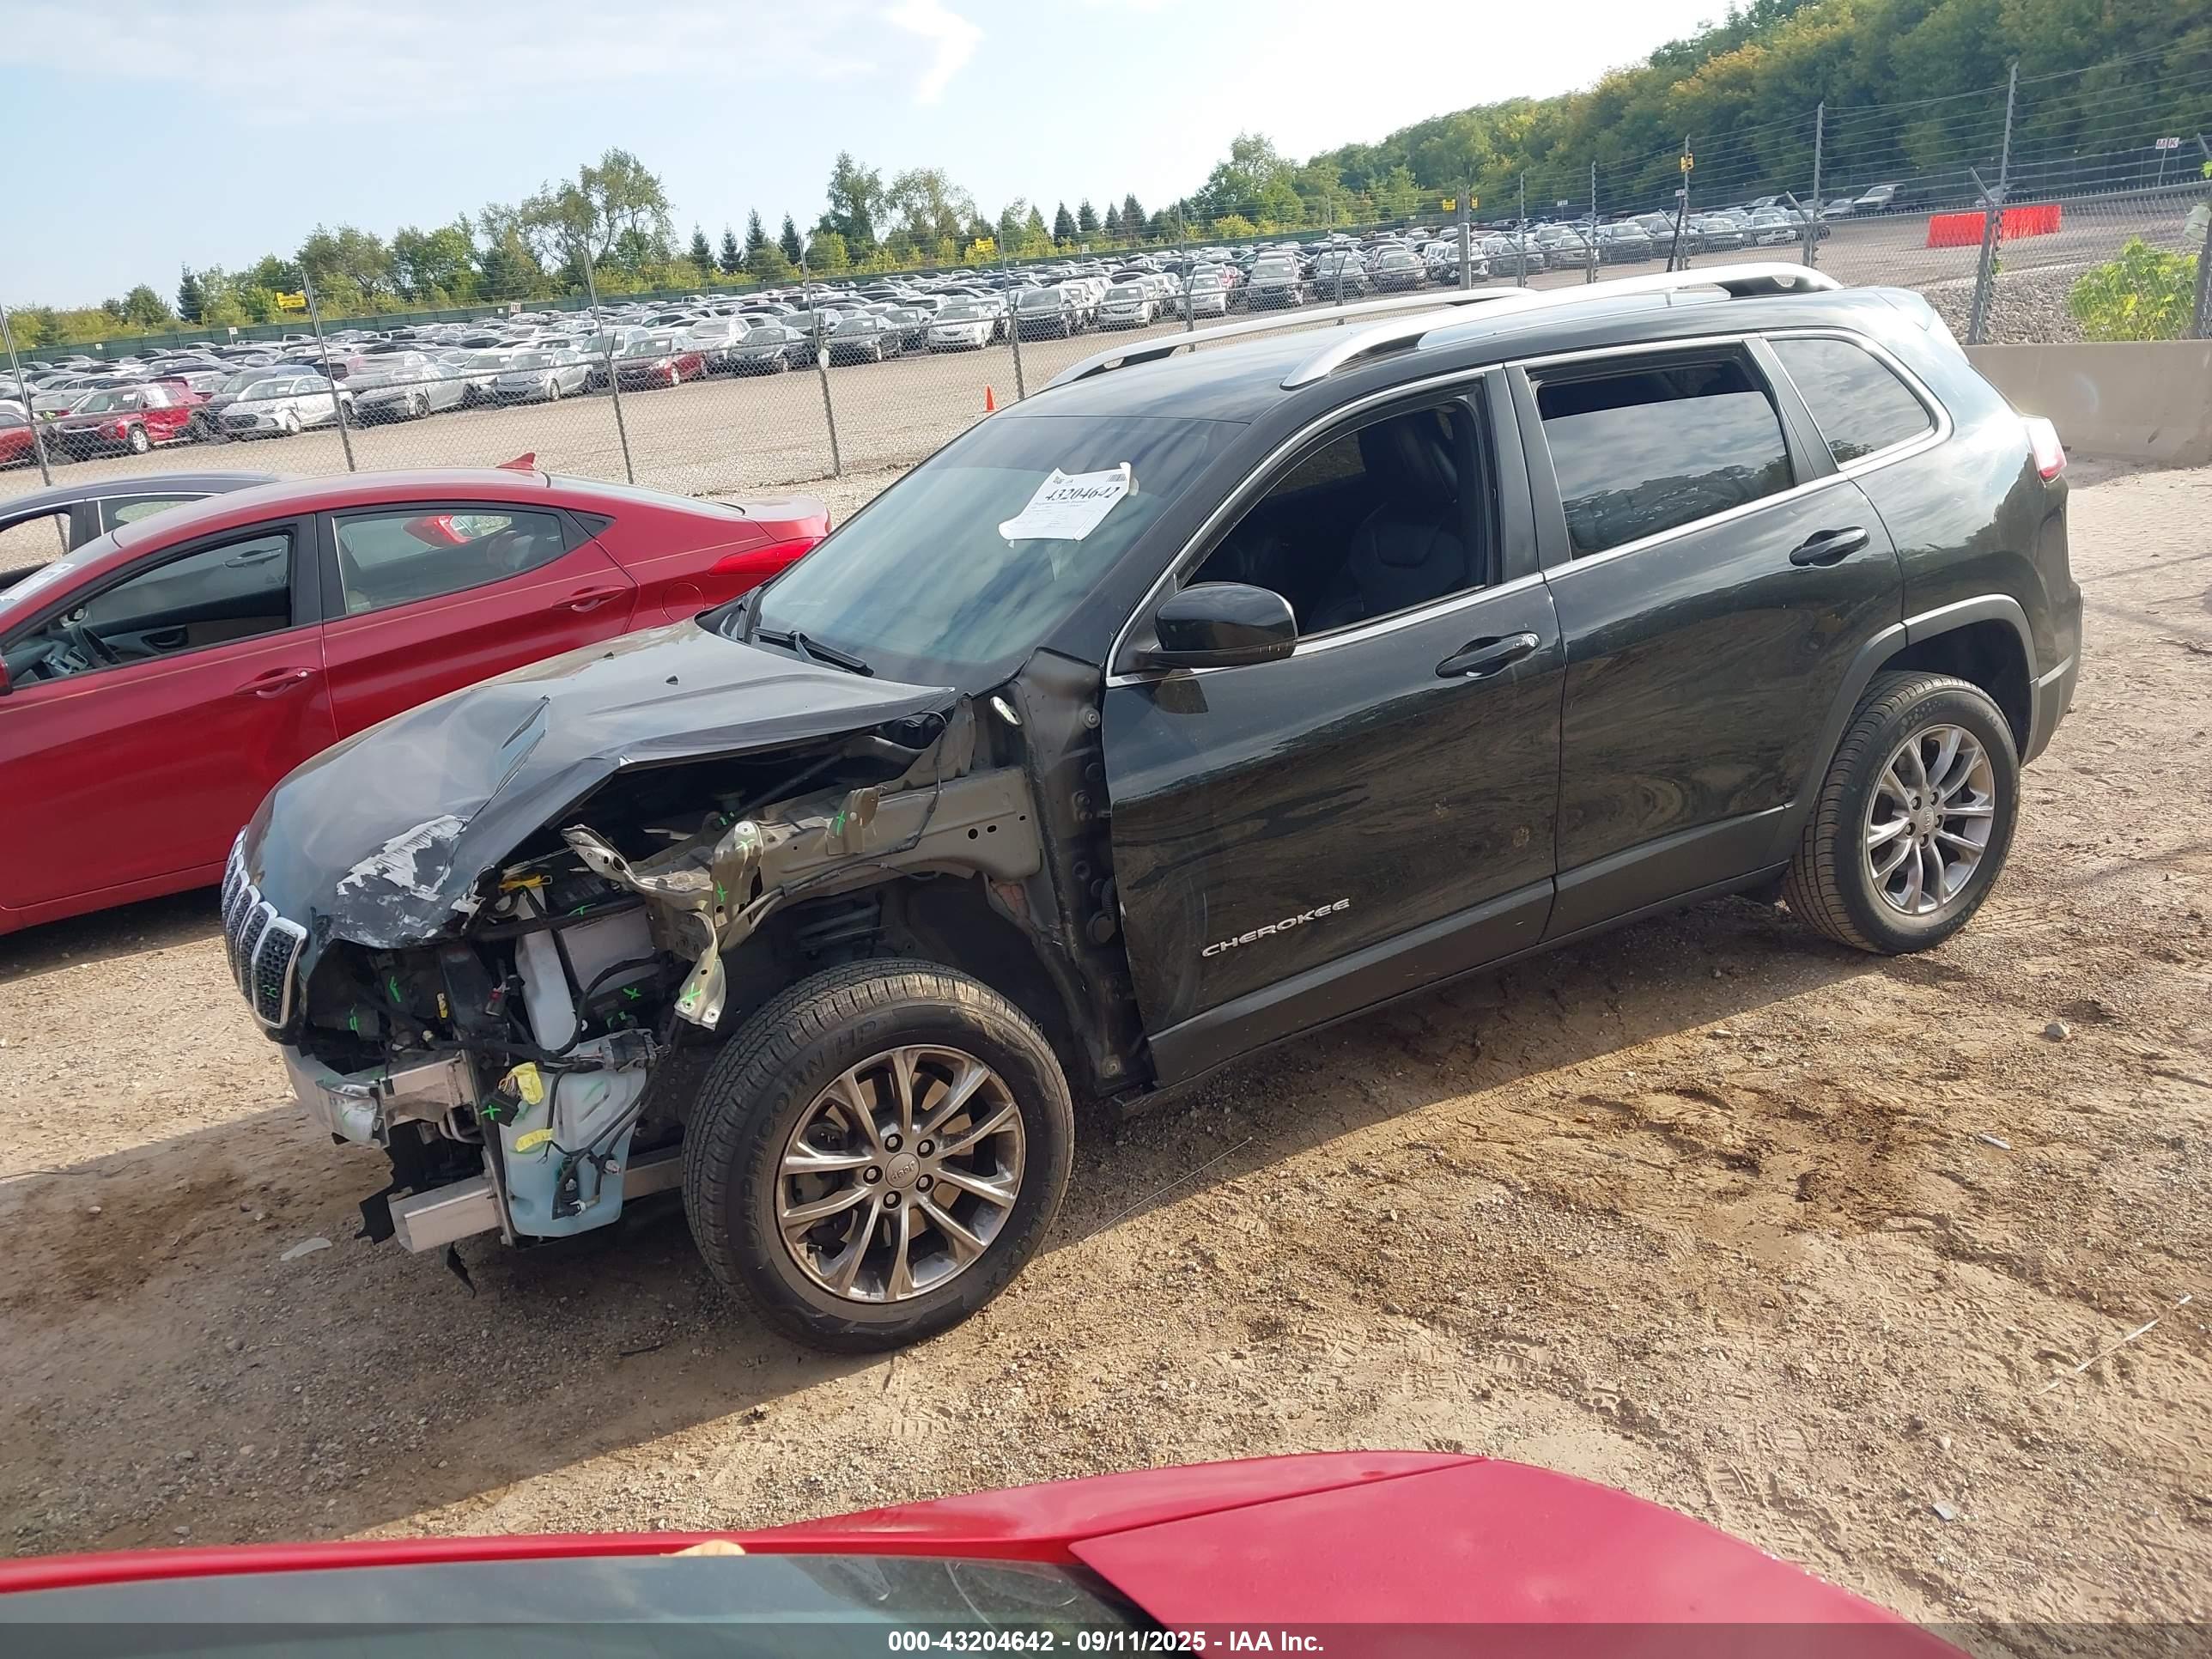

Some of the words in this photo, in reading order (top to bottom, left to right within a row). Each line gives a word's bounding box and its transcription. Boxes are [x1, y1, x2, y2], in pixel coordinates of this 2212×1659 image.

[1045, 487, 1121, 501] 43204642
[1201, 897, 1351, 958] CHEROKEE
[891, 1159, 916, 1182] Jeep
